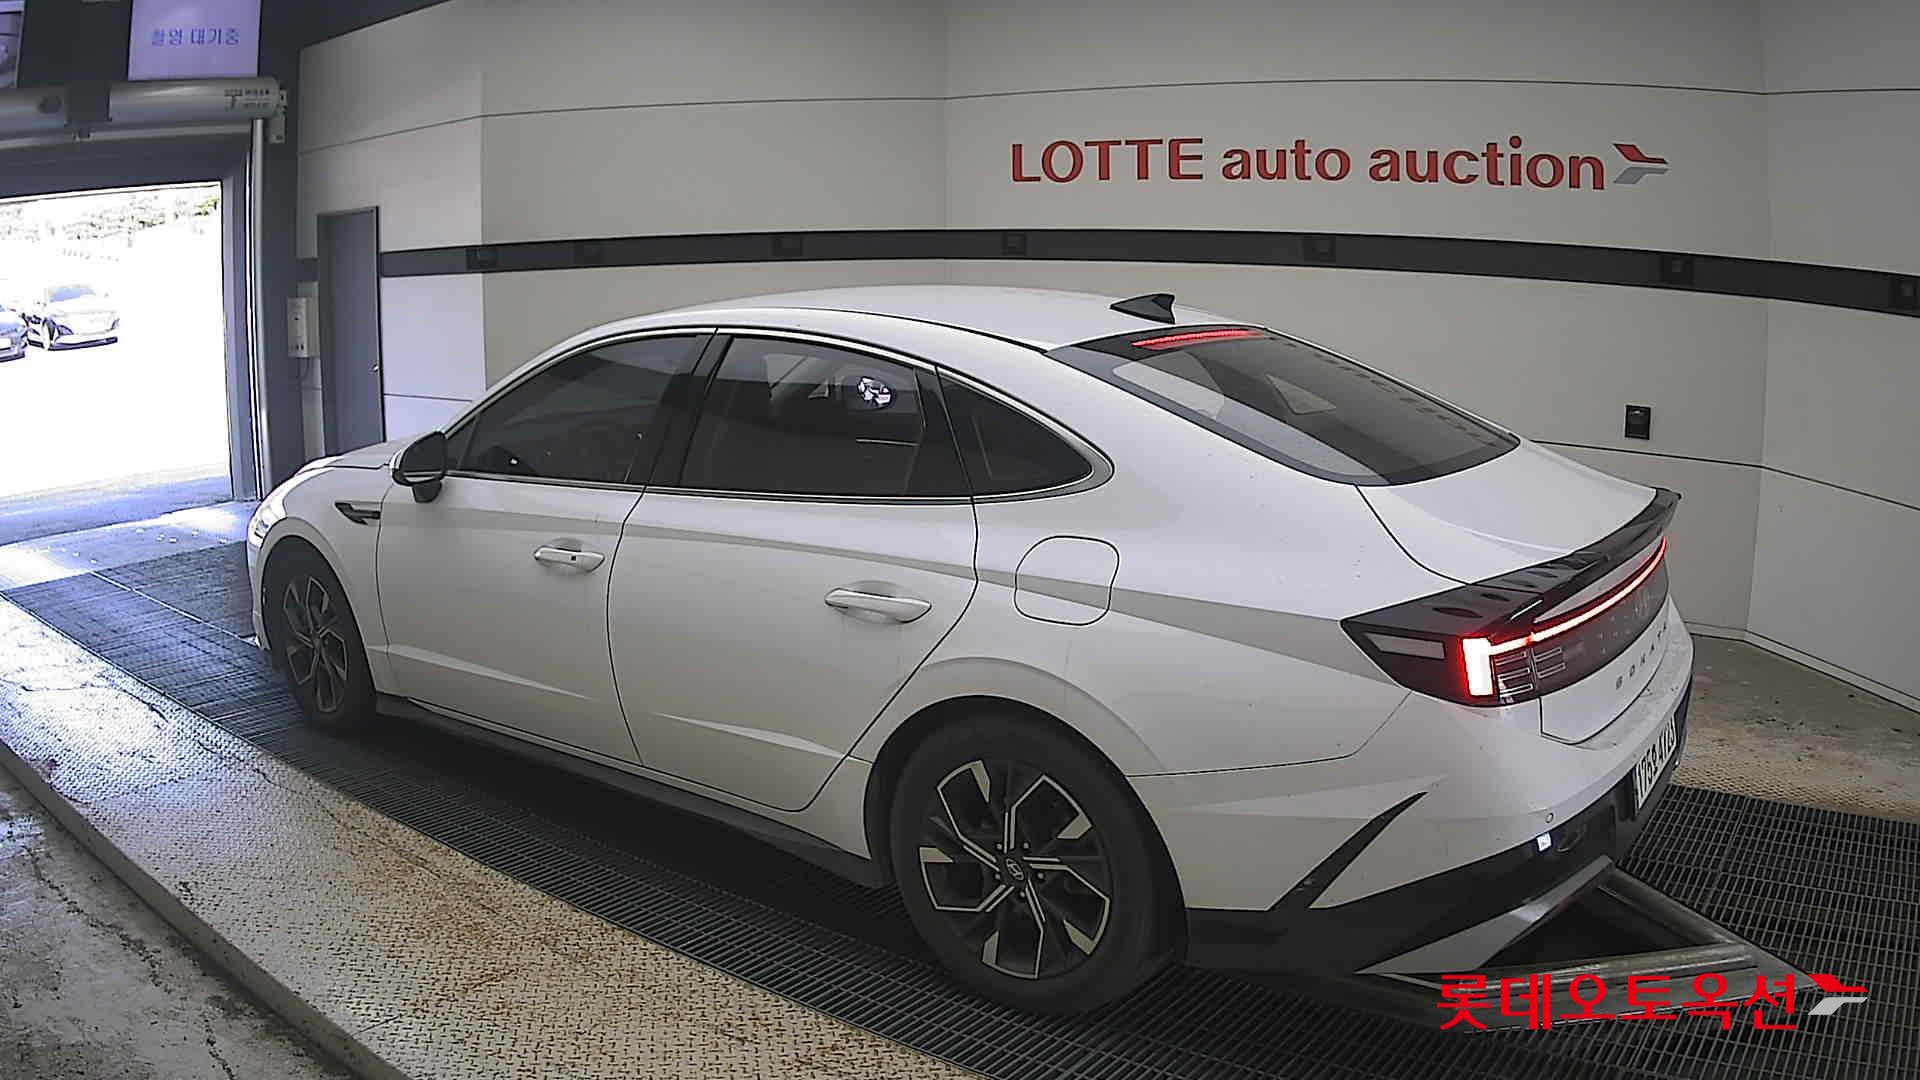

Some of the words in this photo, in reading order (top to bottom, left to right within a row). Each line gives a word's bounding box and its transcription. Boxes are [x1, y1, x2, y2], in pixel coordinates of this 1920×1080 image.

[191, 27, 240, 46] 대기중
[1011, 138, 1203, 183] LOTTE
[1222, 139, 1351, 181] auto
[1368, 135, 1605, 190] auction
